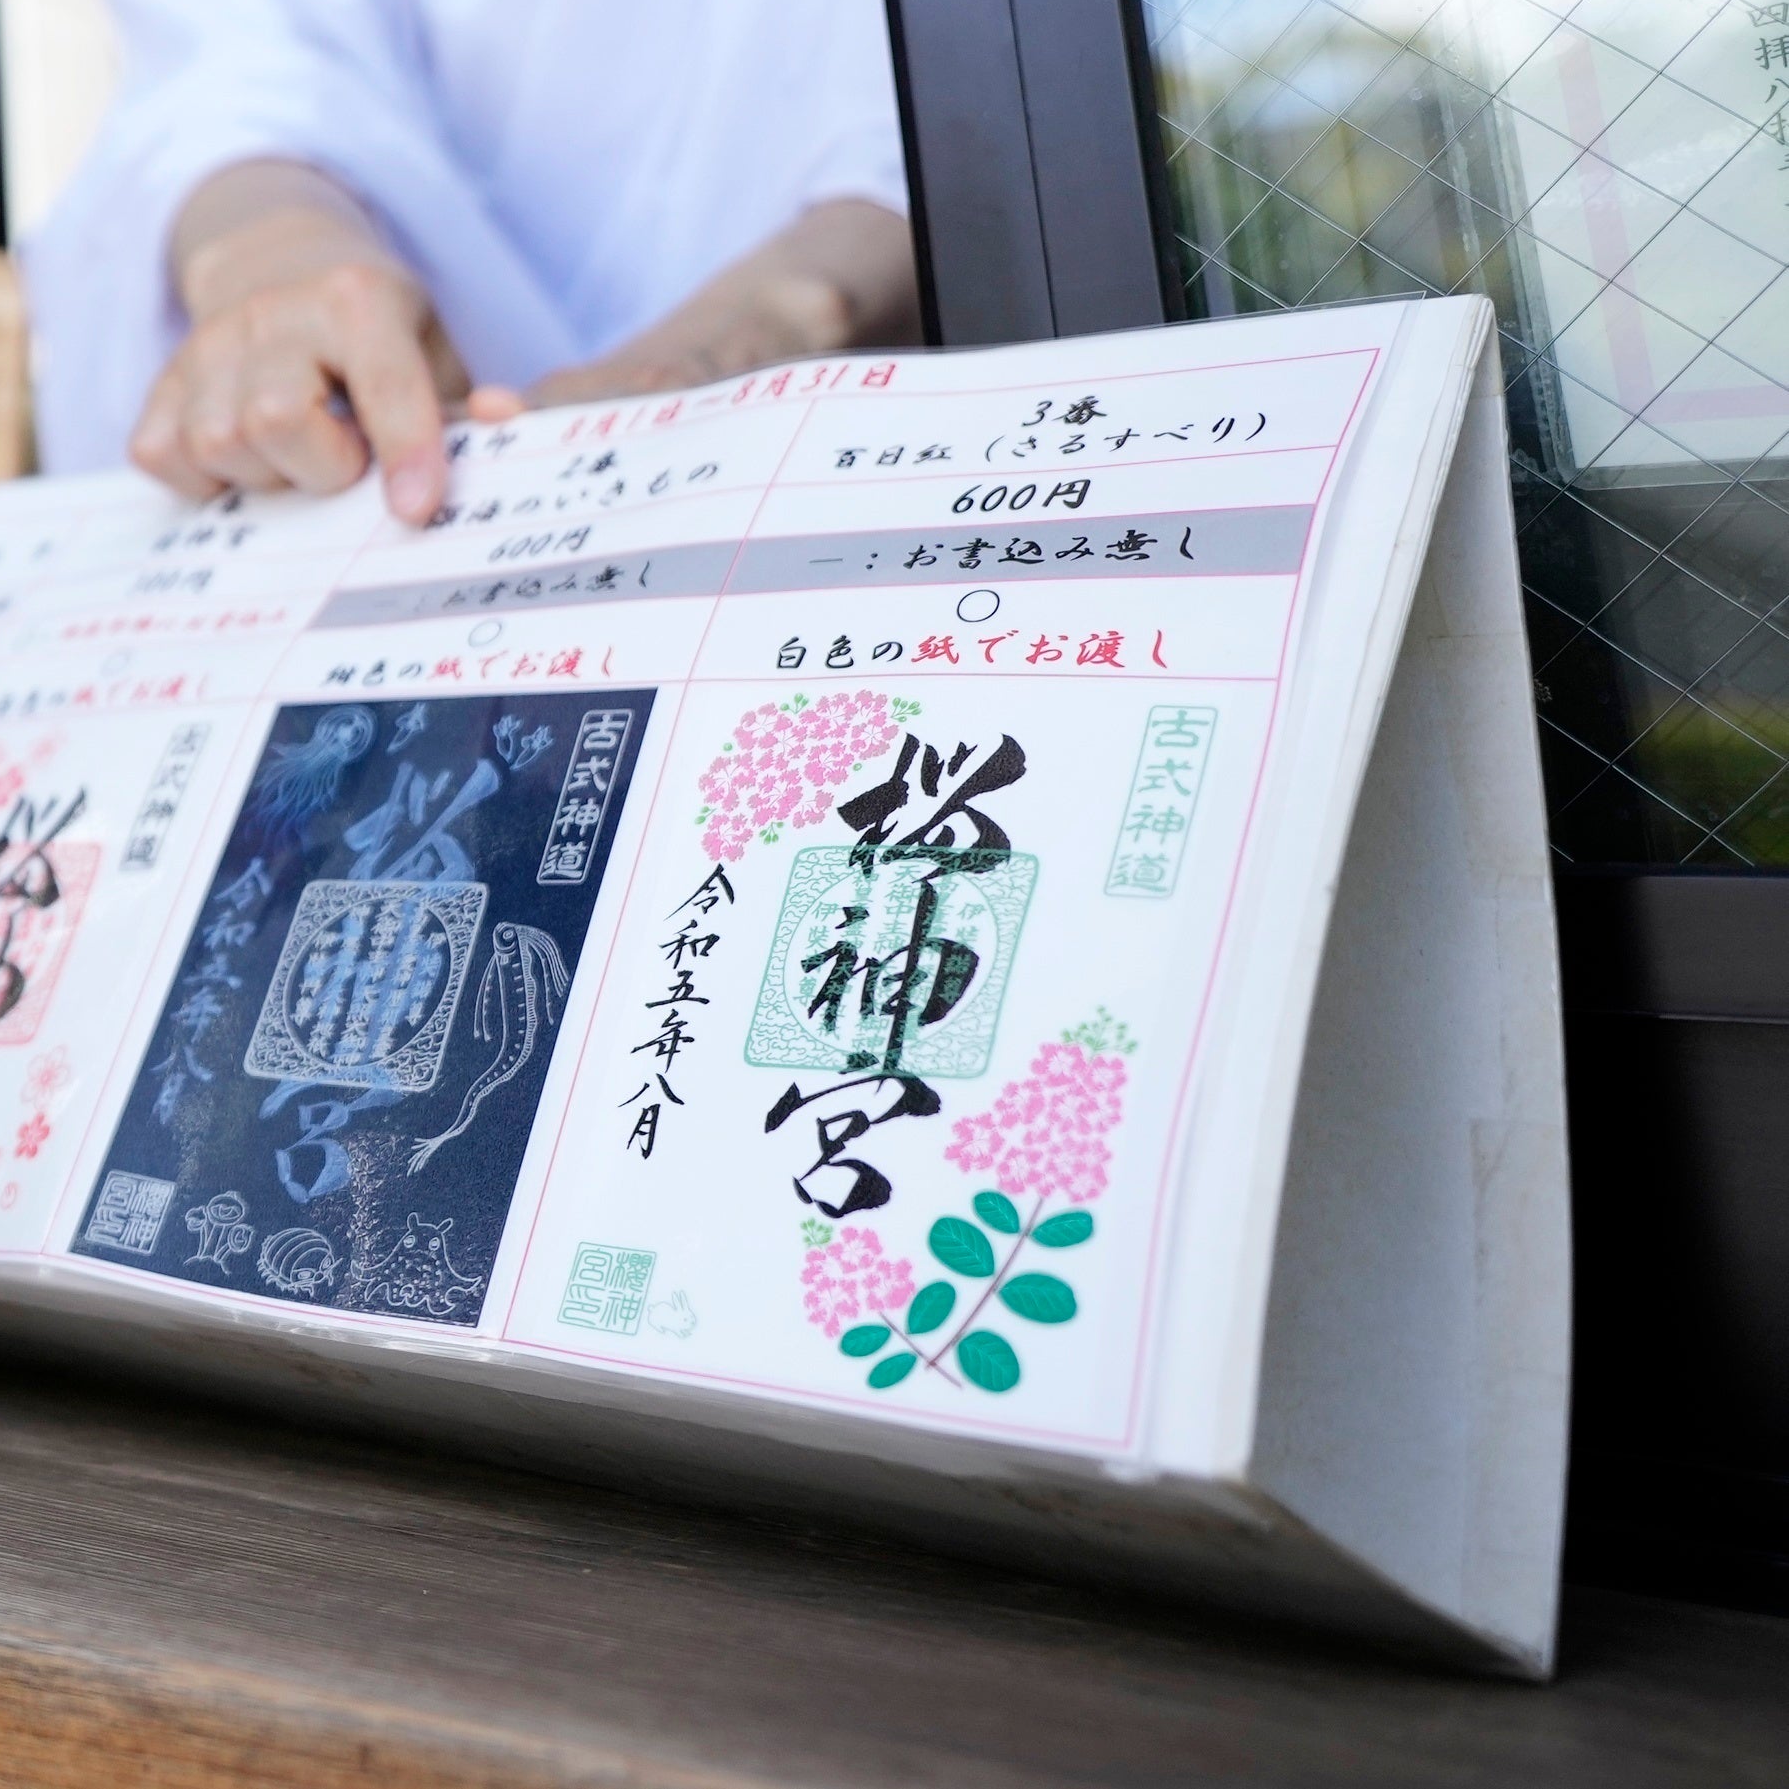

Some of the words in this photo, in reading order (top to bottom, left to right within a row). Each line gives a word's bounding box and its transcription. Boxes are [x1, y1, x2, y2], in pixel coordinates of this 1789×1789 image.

[1022, 395, 1109, 427] 3番
[833, 411, 1267, 469] 百日紅（さるすべり）
[950, 478, 1092, 515] 600円
[487, 524, 591, 564] 600円
[776, 628, 1169, 671] 白色の紙でお渡し
[541, 714, 629, 882] 古式神道
[1111, 709, 1212, 895] 古式神道
[617, 863, 734, 1160] 令和五年八月
